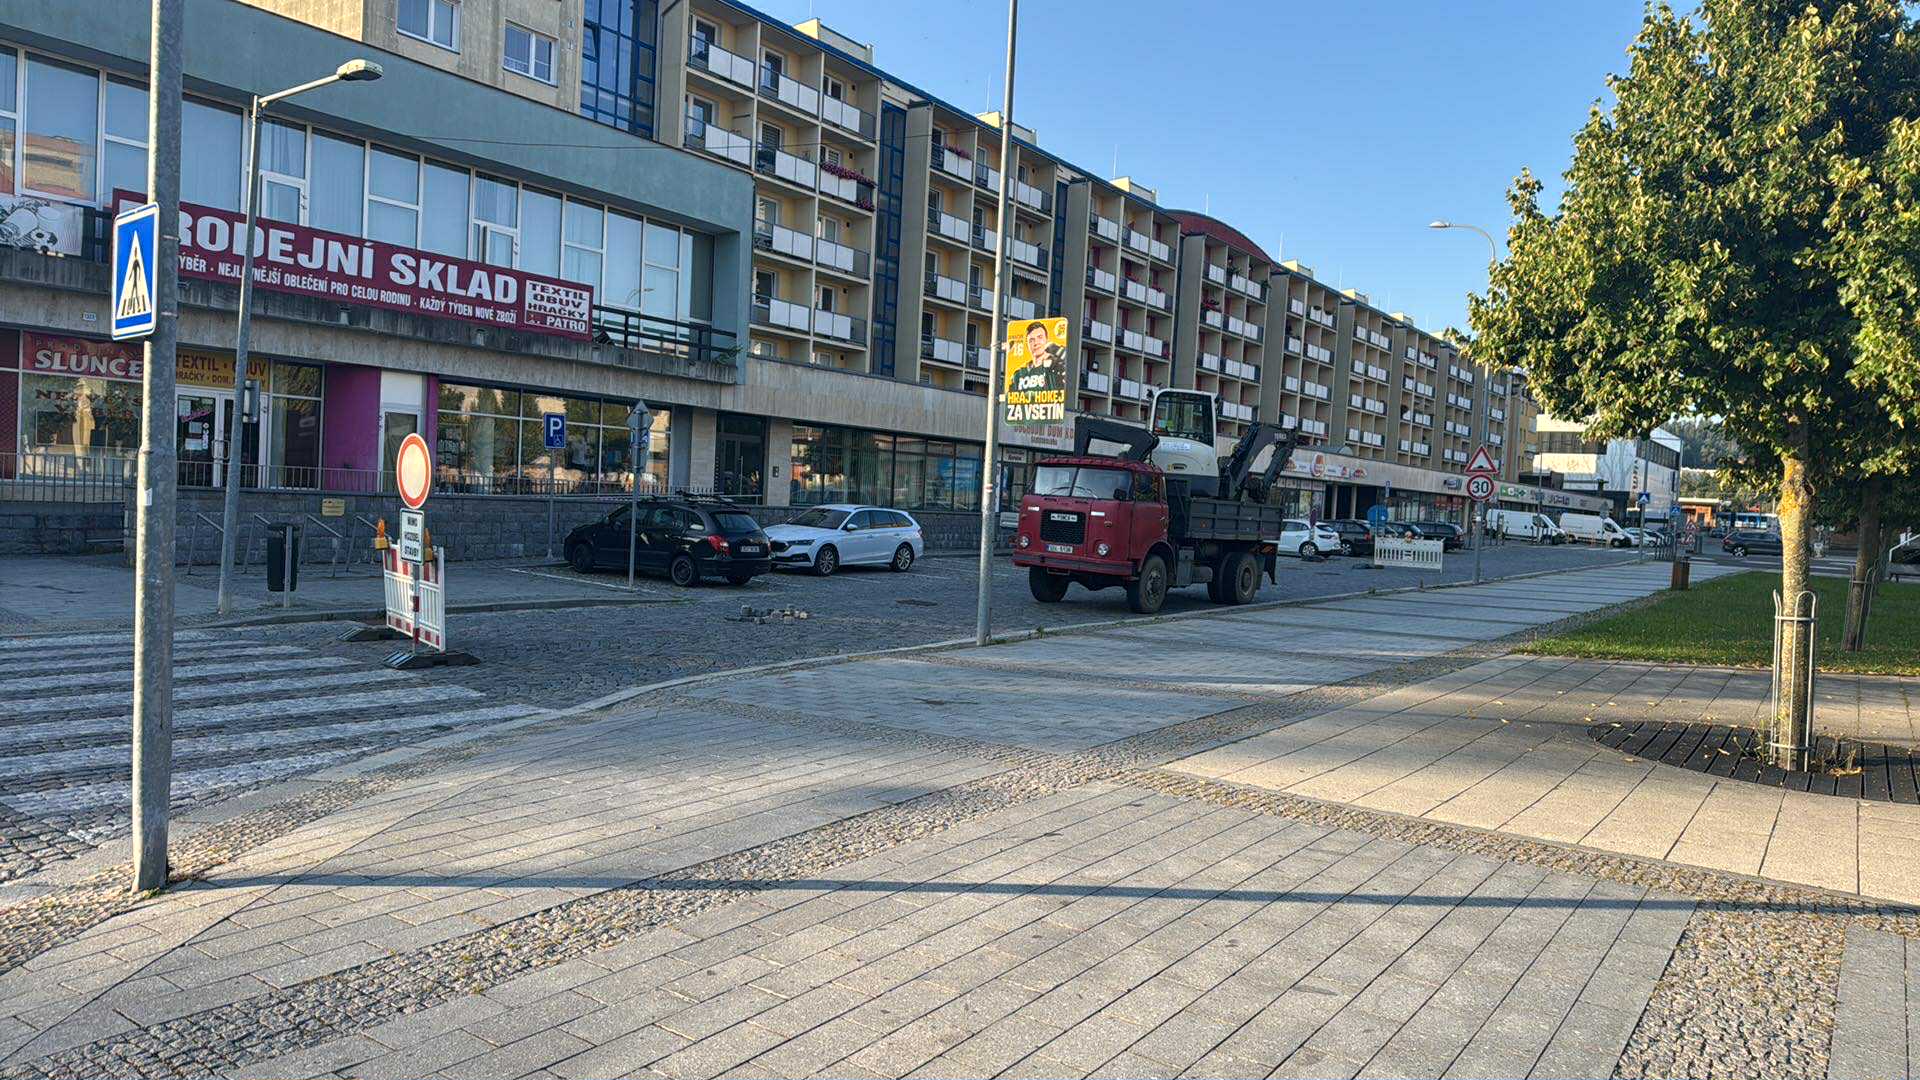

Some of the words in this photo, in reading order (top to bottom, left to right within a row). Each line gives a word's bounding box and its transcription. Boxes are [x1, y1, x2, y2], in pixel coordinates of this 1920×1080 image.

[119, 199, 375, 280] ODEJNÍ
[389, 253, 518, 304] SKLAD
[178, 252, 207, 273] ÝBĚR
[284, 271, 329, 292] OBLEČENÍ
[331, 283, 348, 296] PRO
[351, 285, 379, 301] CELOU
[380, 289, 411, 307] RODINU
[419, 295, 446, 313] KAŽDÝ
[448, 299, 473, 318] TÝDEN
[475, 306, 494, 321] NOVÉ
[496, 309, 517, 324] ZBOŽÍ
[529, 282, 586, 301] TEXTIL
[527, 302, 586, 319] HRAČKY
[533, 293, 583, 309] OBUV
[546, 316, 586, 332] PATRO
[35, 349, 143, 377] SLUNCE
[176, 353, 219, 372] TEXTIL
[1007, 391, 1032, 404] HRAJ
[1034, 389, 1065, 403] HOKEJ
[1007, 404, 1023, 420] ZA
[1024, 401, 1064, 420] VSETÍN
[549, 417, 563, 437] P
[1471, 481, 1490, 494] 30
